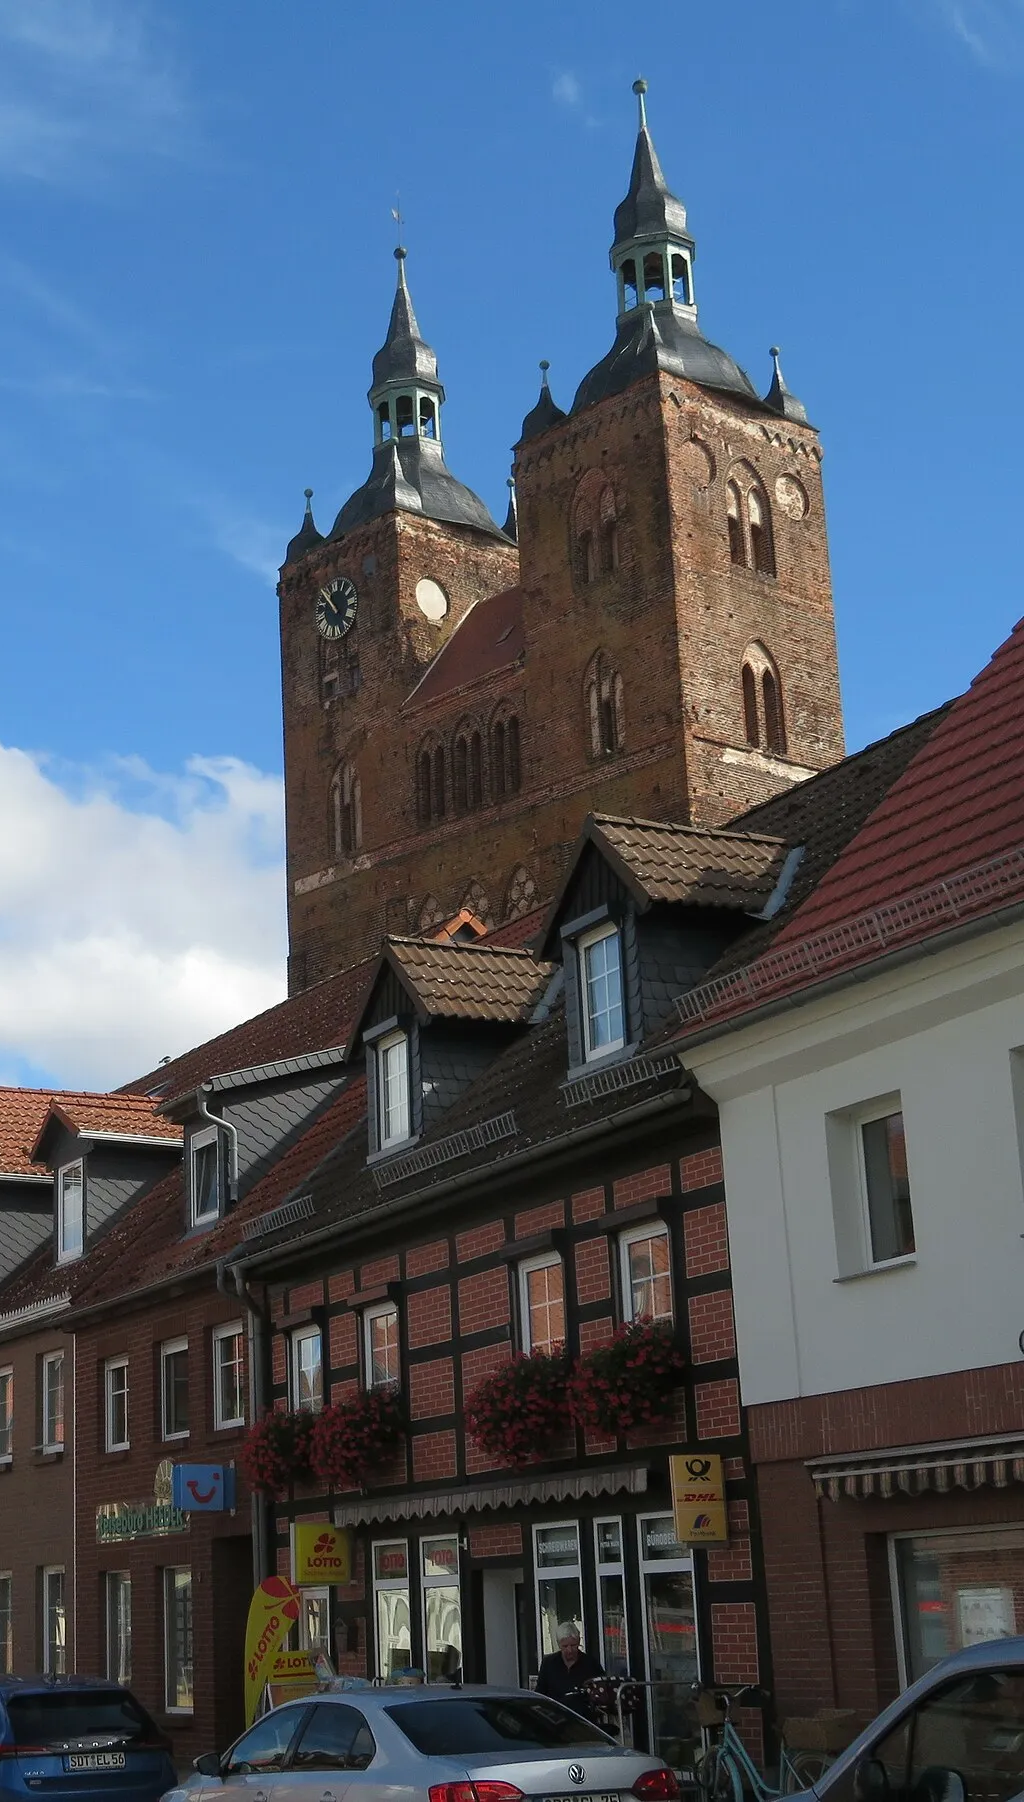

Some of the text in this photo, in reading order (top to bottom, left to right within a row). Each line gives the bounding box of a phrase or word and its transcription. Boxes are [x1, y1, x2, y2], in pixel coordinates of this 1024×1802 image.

[684, 1493, 717, 1502] DHL
[307, 1557, 343, 1568] LOTTO
[254, 1615, 280, 1662] LOTTO
[70, 1753, 124, 1767] SDT EL 56
